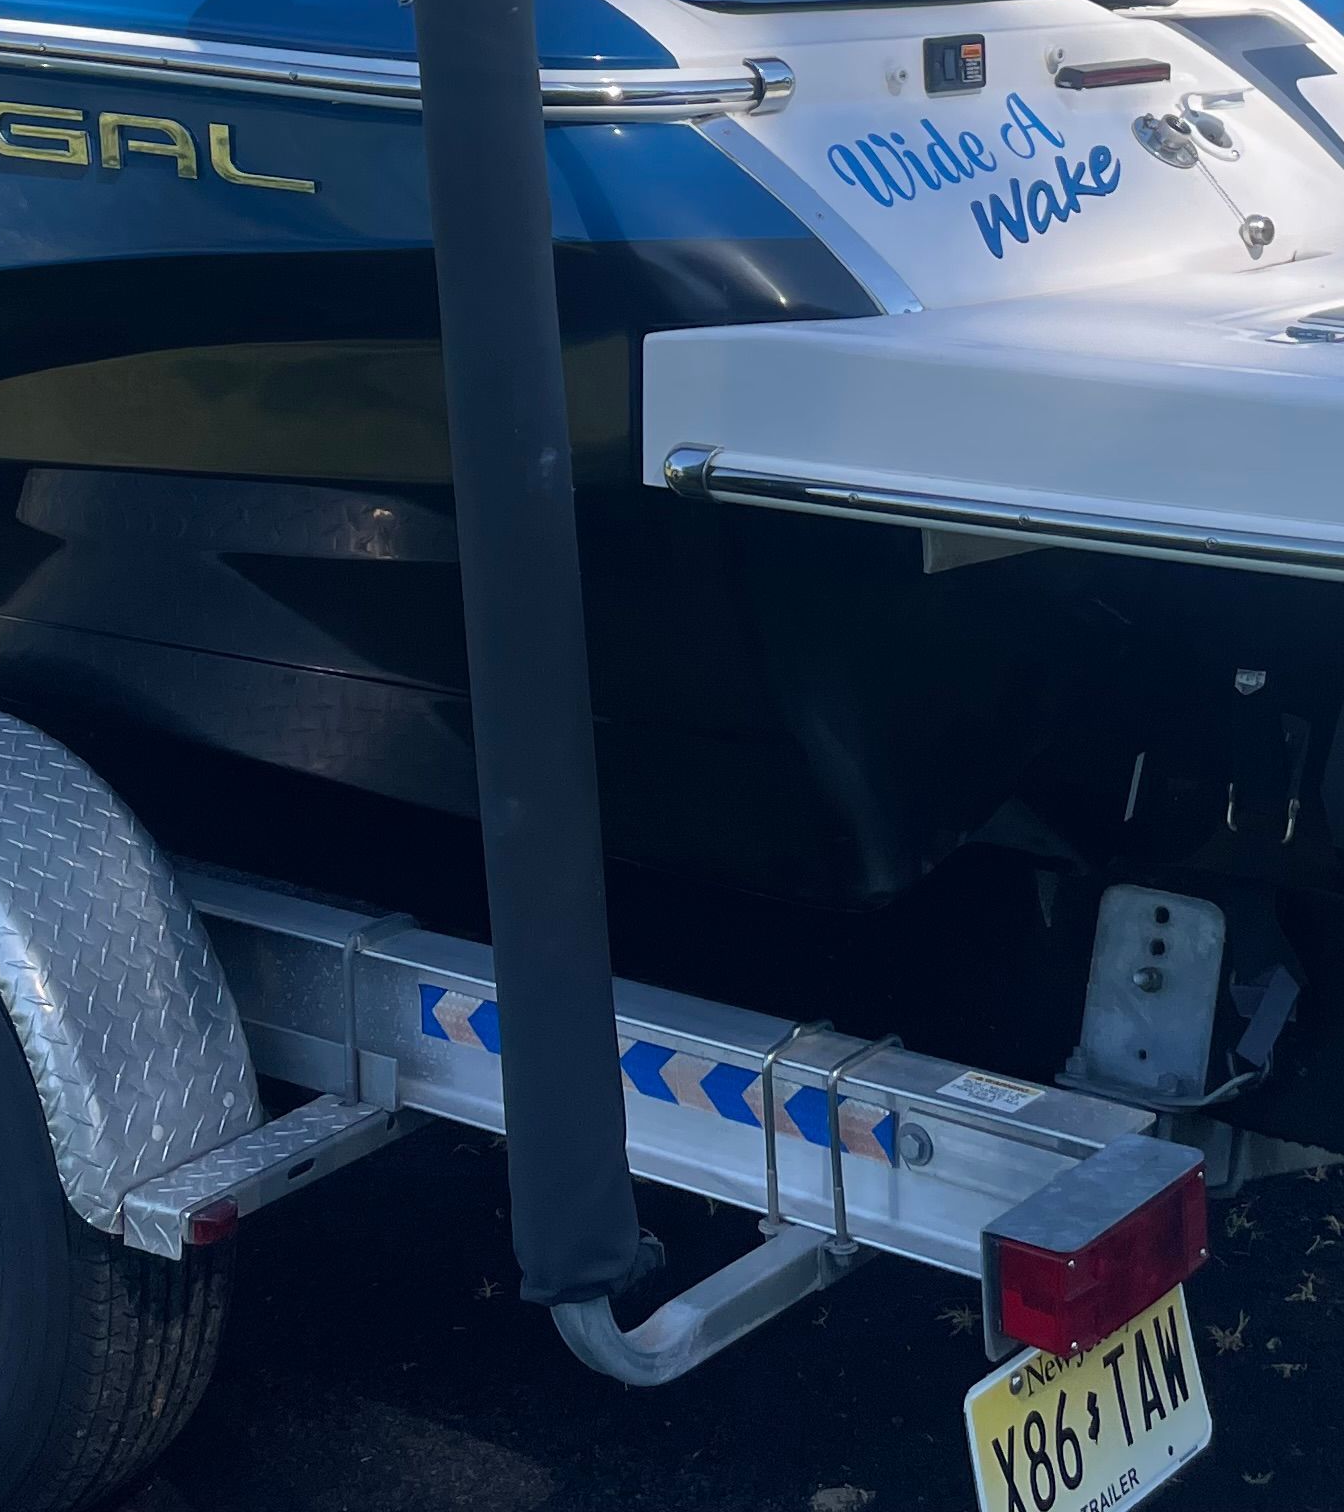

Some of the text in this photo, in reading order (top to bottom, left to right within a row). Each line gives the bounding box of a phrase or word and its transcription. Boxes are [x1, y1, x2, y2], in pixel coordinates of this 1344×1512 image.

[827, 92, 1065, 208] Wide A
[970, 144, 1121, 259] Wake
[991, 1305, 1190, 1512] X86 TAW
[1024, 1354, 1071, 1397] New
